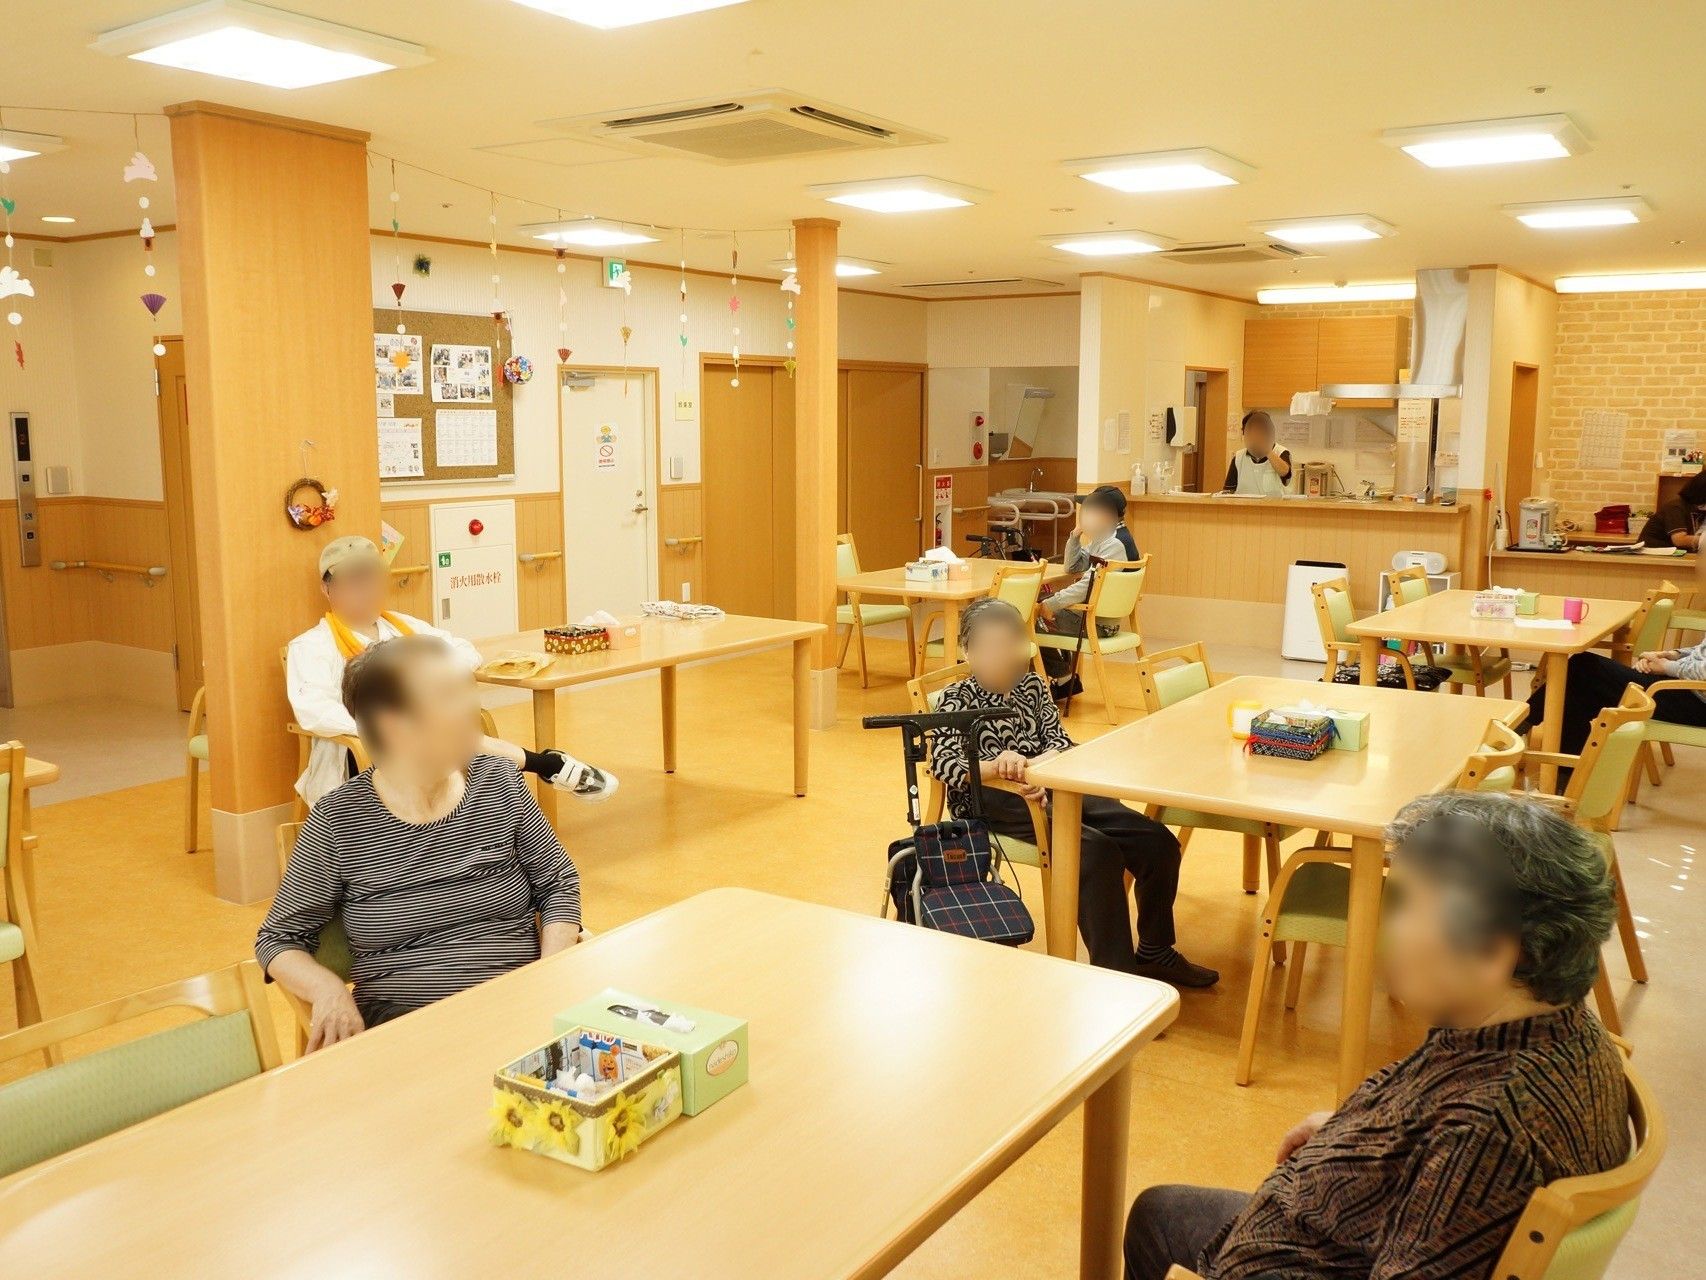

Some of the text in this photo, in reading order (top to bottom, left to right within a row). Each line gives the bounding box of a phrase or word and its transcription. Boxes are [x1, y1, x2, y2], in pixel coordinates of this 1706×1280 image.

[450, 571, 501, 589] 消火用散水栓
